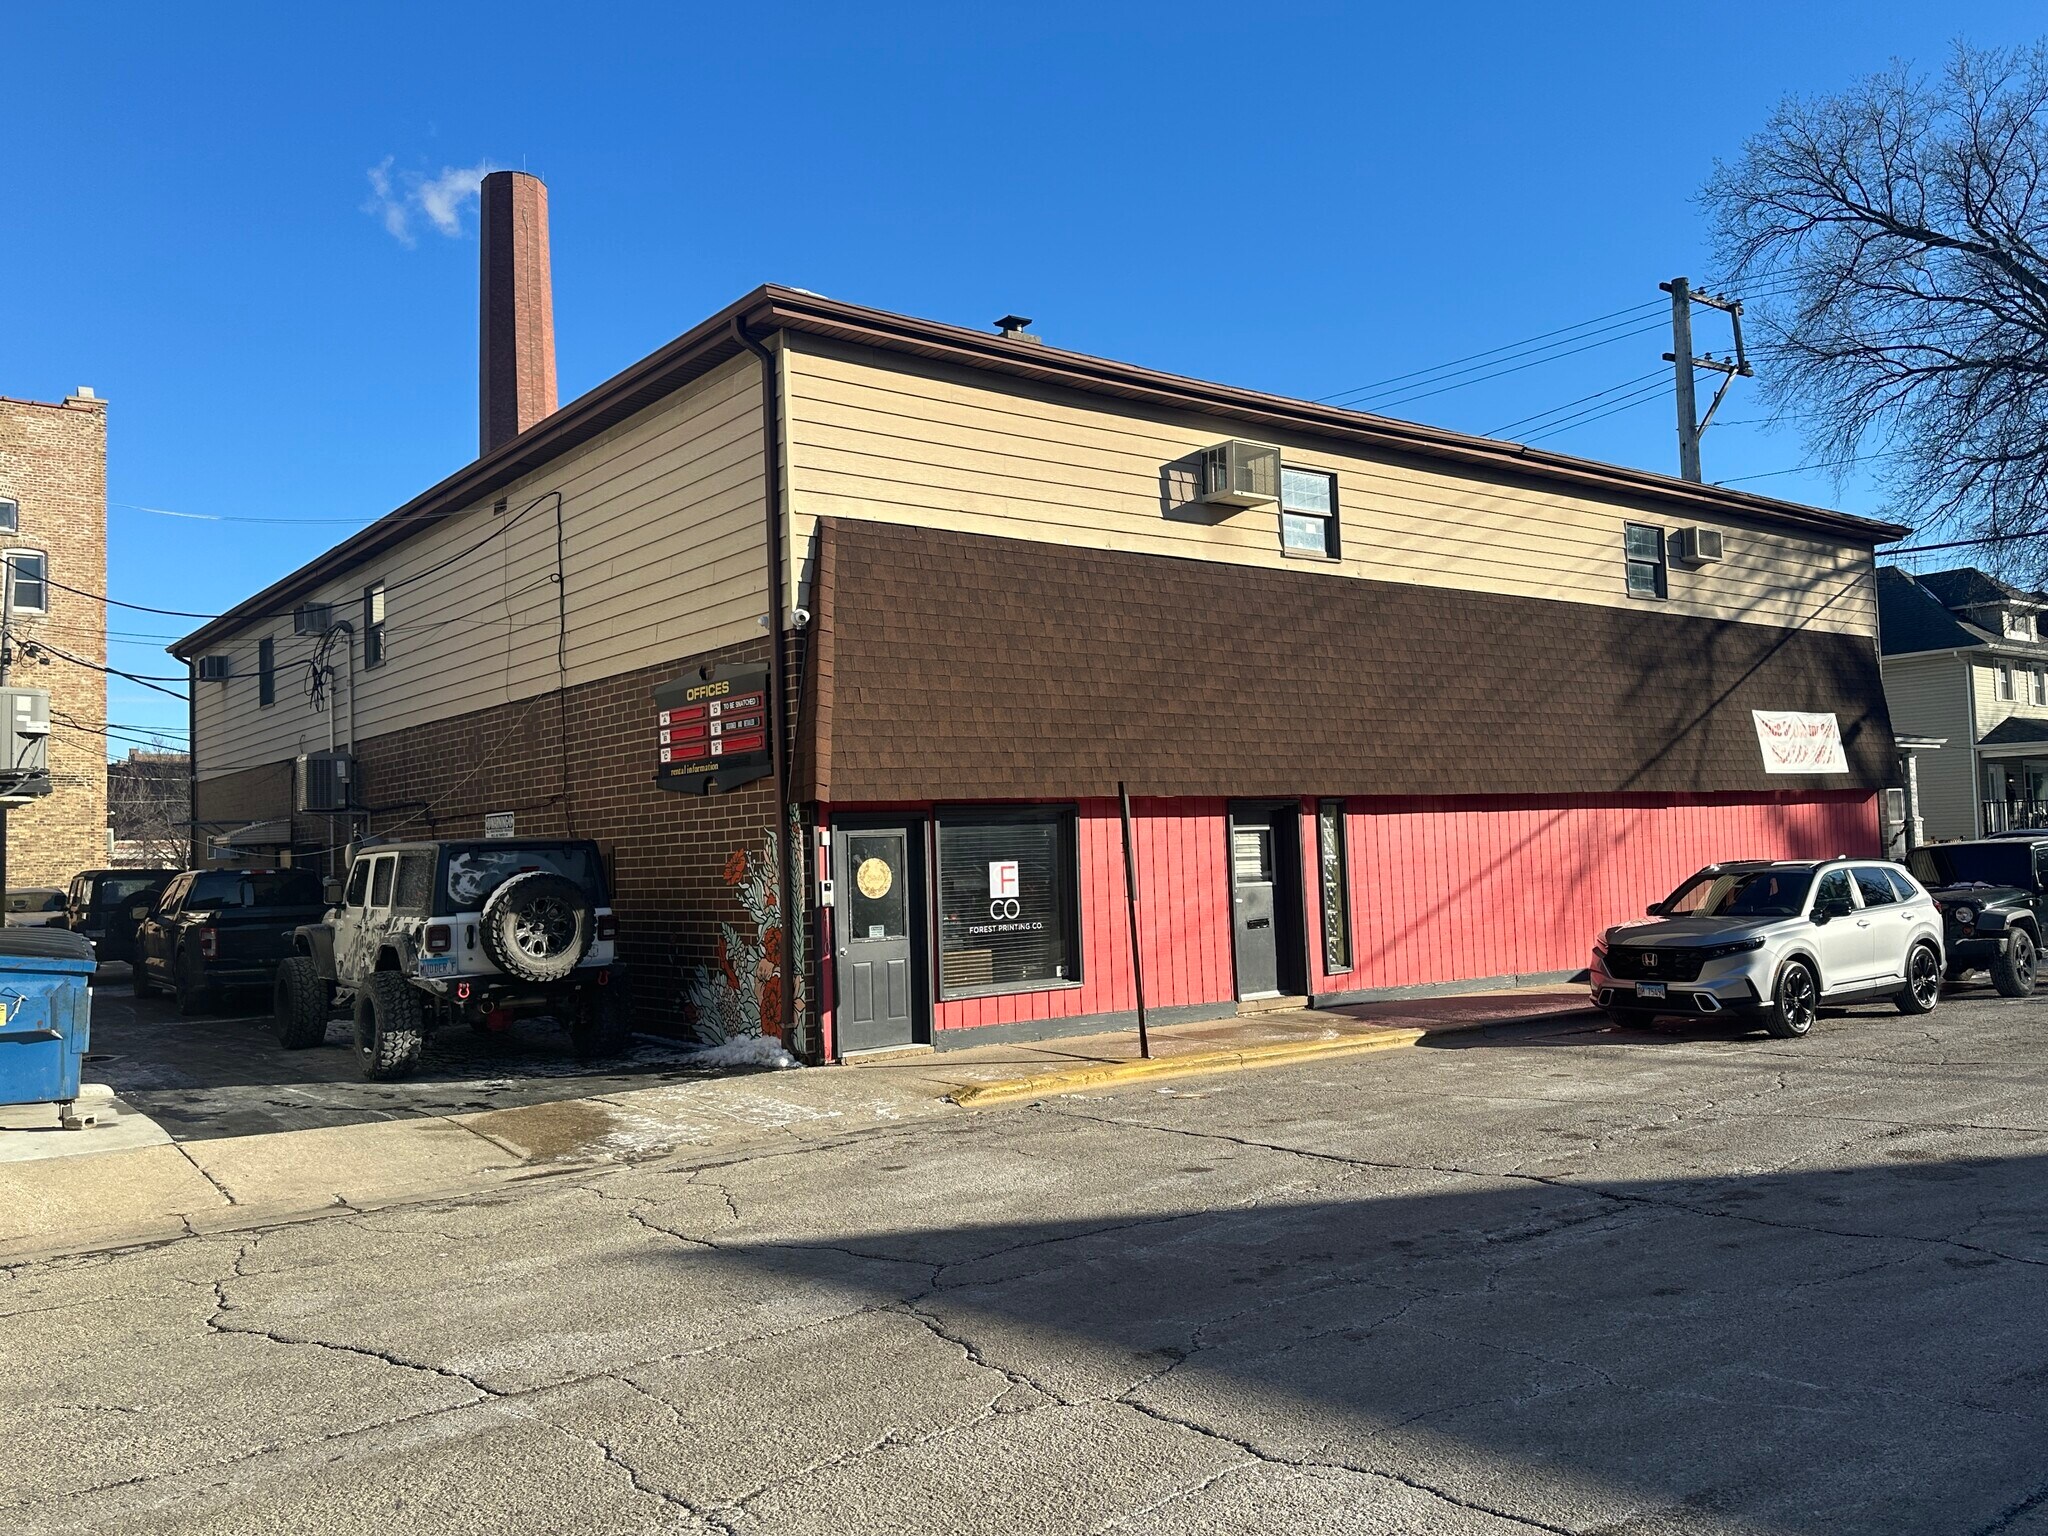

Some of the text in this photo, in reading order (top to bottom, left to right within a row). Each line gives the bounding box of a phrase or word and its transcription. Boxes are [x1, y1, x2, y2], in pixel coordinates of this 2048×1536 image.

[686, 681, 730, 701] OFFICES
[735, 697, 756, 708] SNATCHED
[671, 762, 719, 776] rental information
[1001, 866, 1015, 894] F
[990, 899, 1020, 920] CO
[969, 922, 1044, 934] FOREST PRINTING CO.
